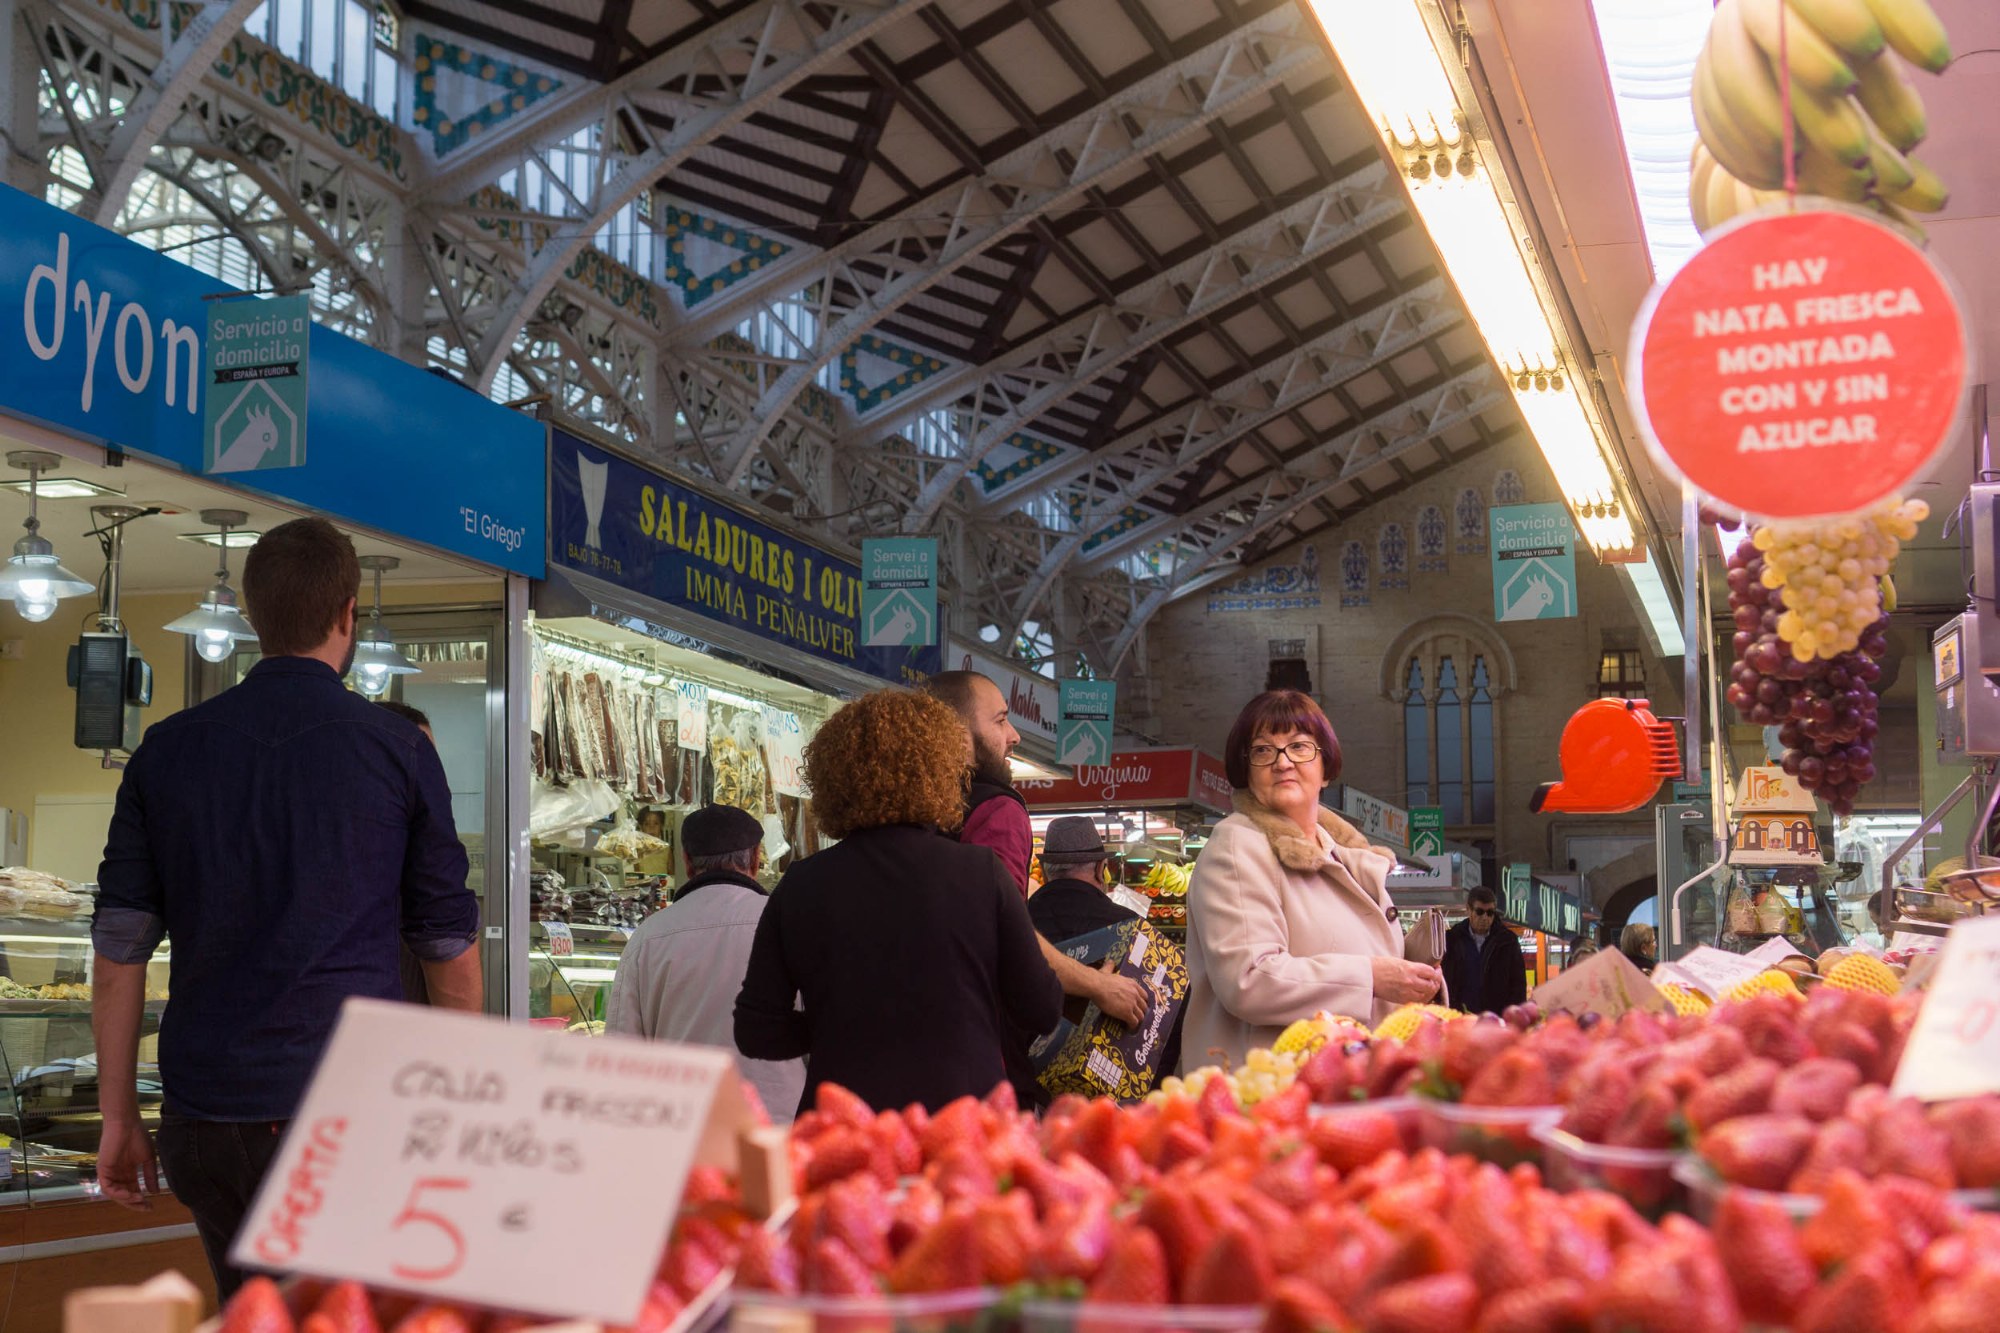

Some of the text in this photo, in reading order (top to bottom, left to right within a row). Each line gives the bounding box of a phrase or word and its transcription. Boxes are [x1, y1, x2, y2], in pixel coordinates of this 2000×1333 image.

[1753, 257, 1828, 291] HAY
[23, 232, 208, 415] dyon
[1694, 287, 1923, 337] NATA FRESCA
[214, 315, 303, 341] Servicio a
[215, 339, 300, 367] domicilio
[1717, 332, 1895, 374] MONTADA
[233, 366, 289, 380] ESPAÑA Y EUROPA
[1720, 374, 1888, 414] CON Y SIN
[1737, 414, 1878, 453] AZUCAR
[1495, 515, 1568, 532] Servicio a
[568, 542, 588, 563] BAJO
[639, 485, 794, 594] SALADURES
[803, 558, 812, 601] I
[1499, 531, 1567, 549] domicilio
[1513, 550, 1533, 558] ESPAÑA
[874, 548, 928, 562] Servei a
[872, 564, 928, 579] domicili
[685, 565, 855, 659] IMMA PEÑALVER
[1066, 702, 1108, 713] domicili
[1068, 687, 1108, 700] Servei a
[1076, 764, 1152, 800] Virginia
[391, 1176, 472, 1282] 5
